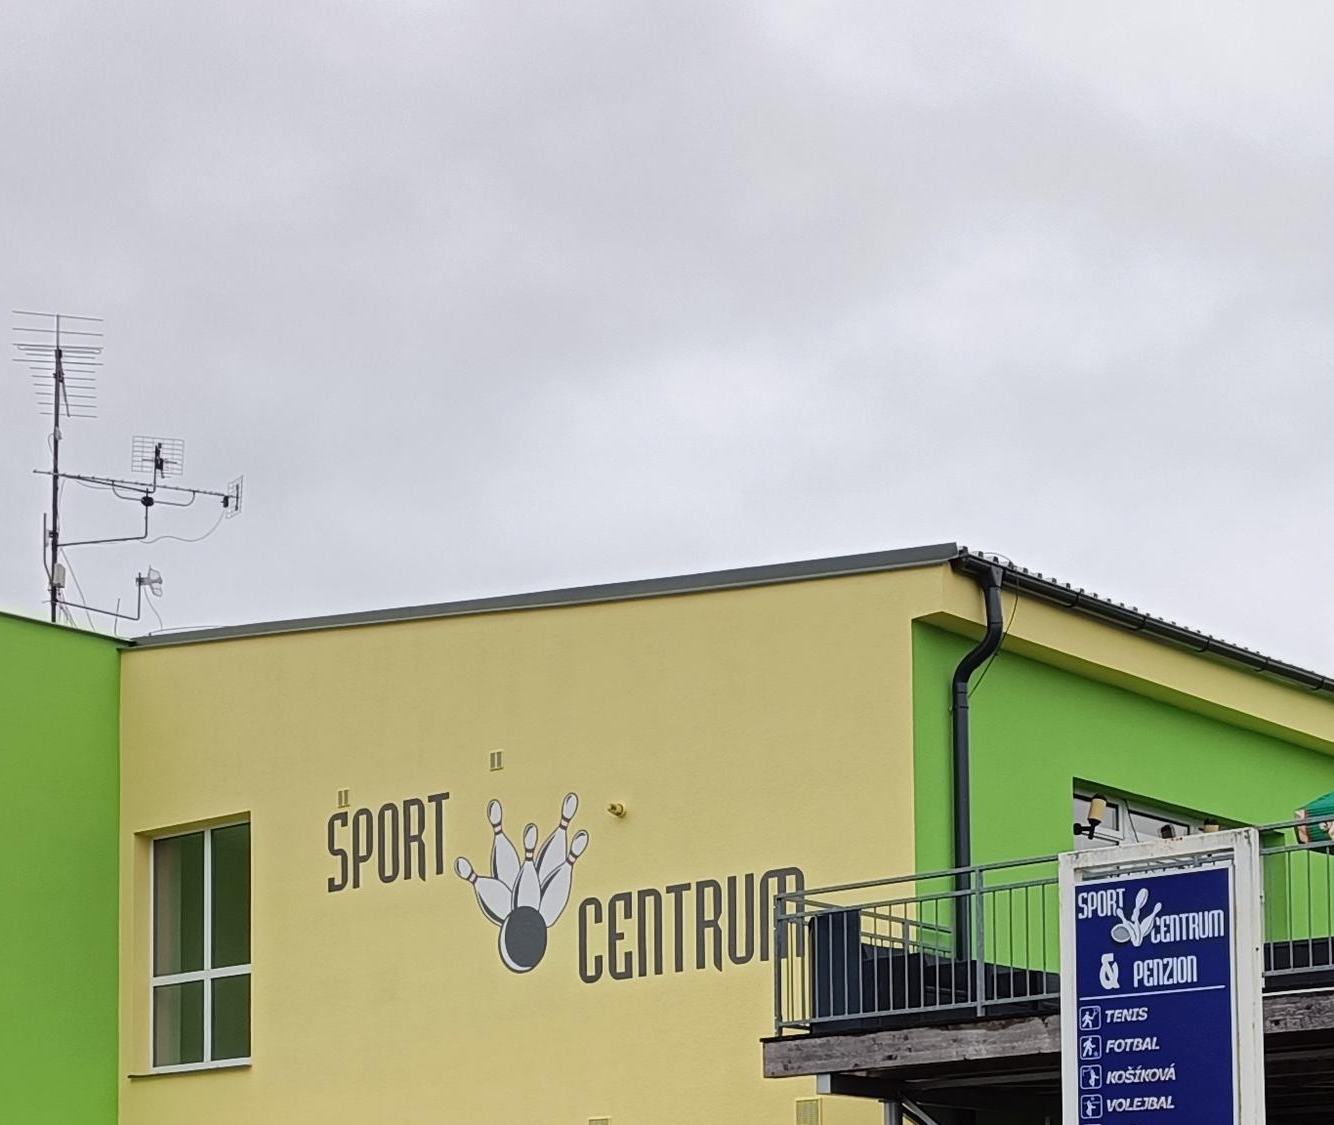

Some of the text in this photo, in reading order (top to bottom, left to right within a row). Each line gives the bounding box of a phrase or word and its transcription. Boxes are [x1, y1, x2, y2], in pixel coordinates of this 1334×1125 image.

[328, 791, 805, 984] SPORT CENTRUM
[1078, 888, 1225, 943] SPORT CENTRUM
[1099, 953, 1198, 989] & PENZION
[1105, 1007, 1148, 1023] TENIS
[1105, 1037, 1160, 1053] FOTBAL
[1106, 1063, 1176, 1084] KOŠÍKOVÁ
[1106, 1095, 1175, 1112] VOLEJBAL
